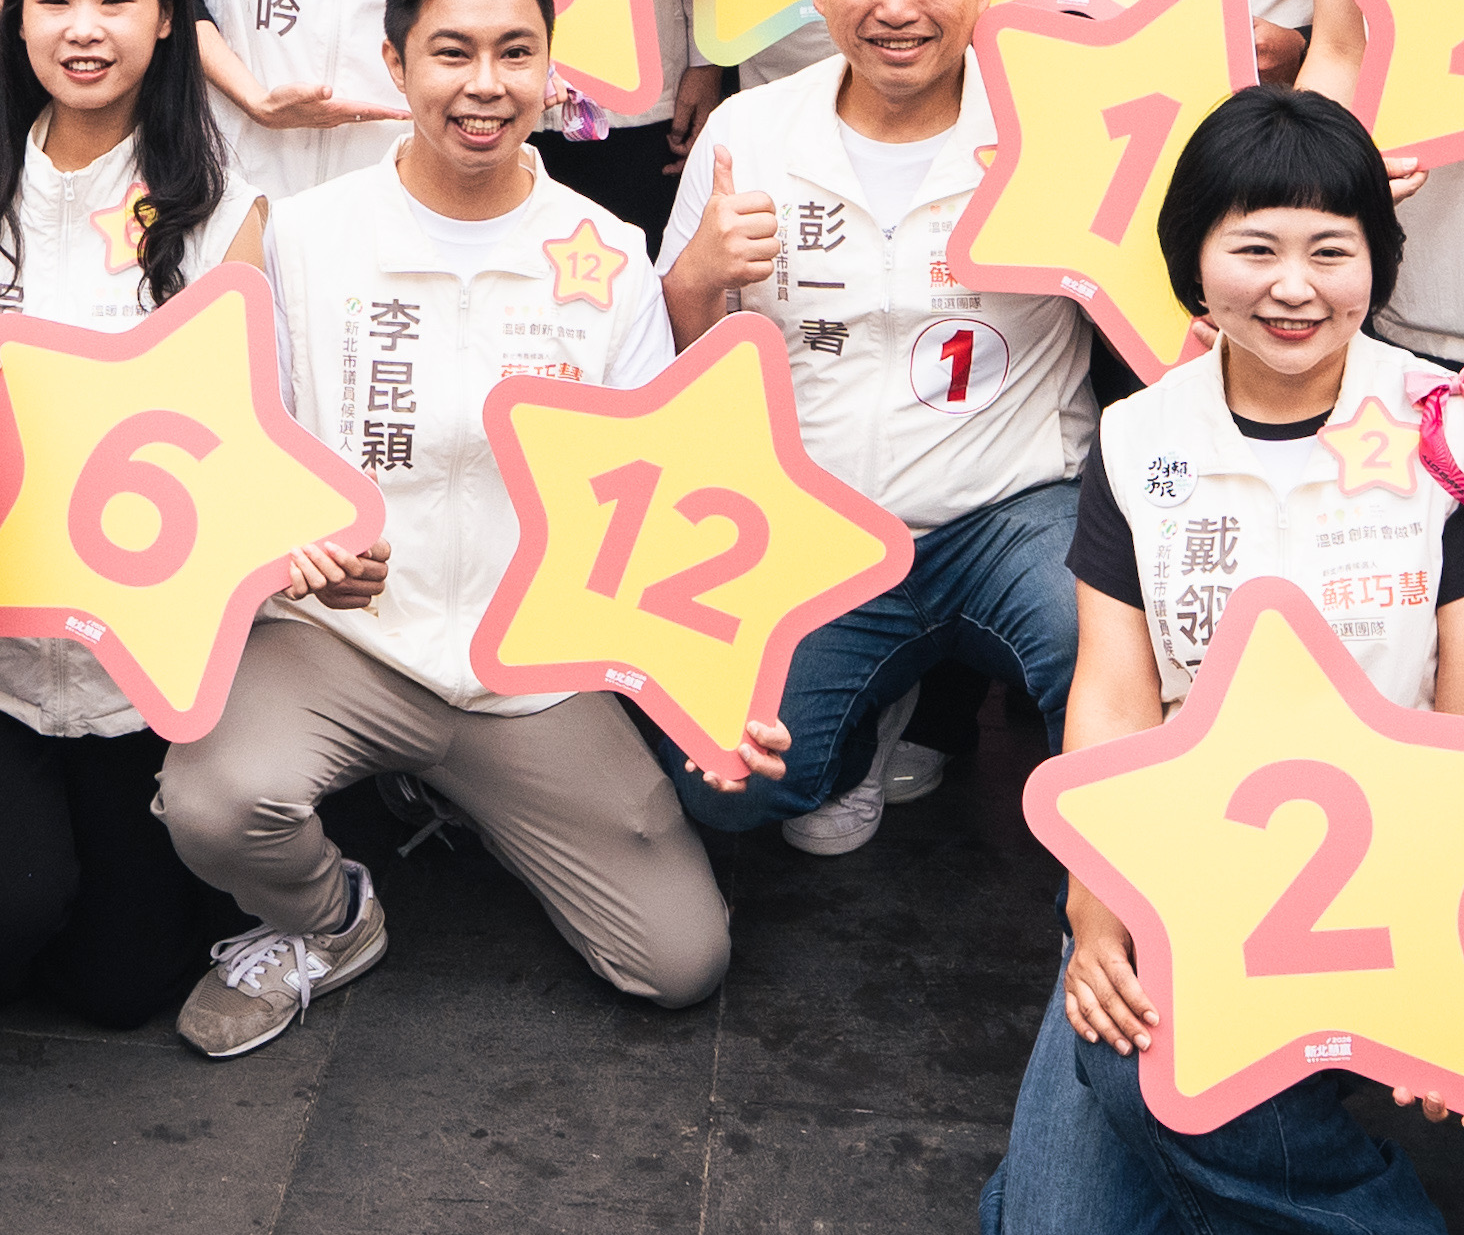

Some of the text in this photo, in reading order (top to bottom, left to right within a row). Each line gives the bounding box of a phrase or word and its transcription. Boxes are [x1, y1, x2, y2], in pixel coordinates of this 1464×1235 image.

[1088, 91, 1184, 248] 1
[566, 253, 603, 280] 12
[796, 200, 850, 357] 彭一者
[339, 320, 360, 453] 新北市議員候選人
[361, 298, 421, 472] 李昆穎
[939, 329, 974, 403] 1
[67, 409, 223, 588] 6
[1360, 430, 1392, 469] 2
[584, 458, 772, 646] 12
[1175, 516, 1241, 676] 戴翎
[1321, 570, 1430, 612] 蘇巧慧
[1224, 758, 1396, 978] 2
